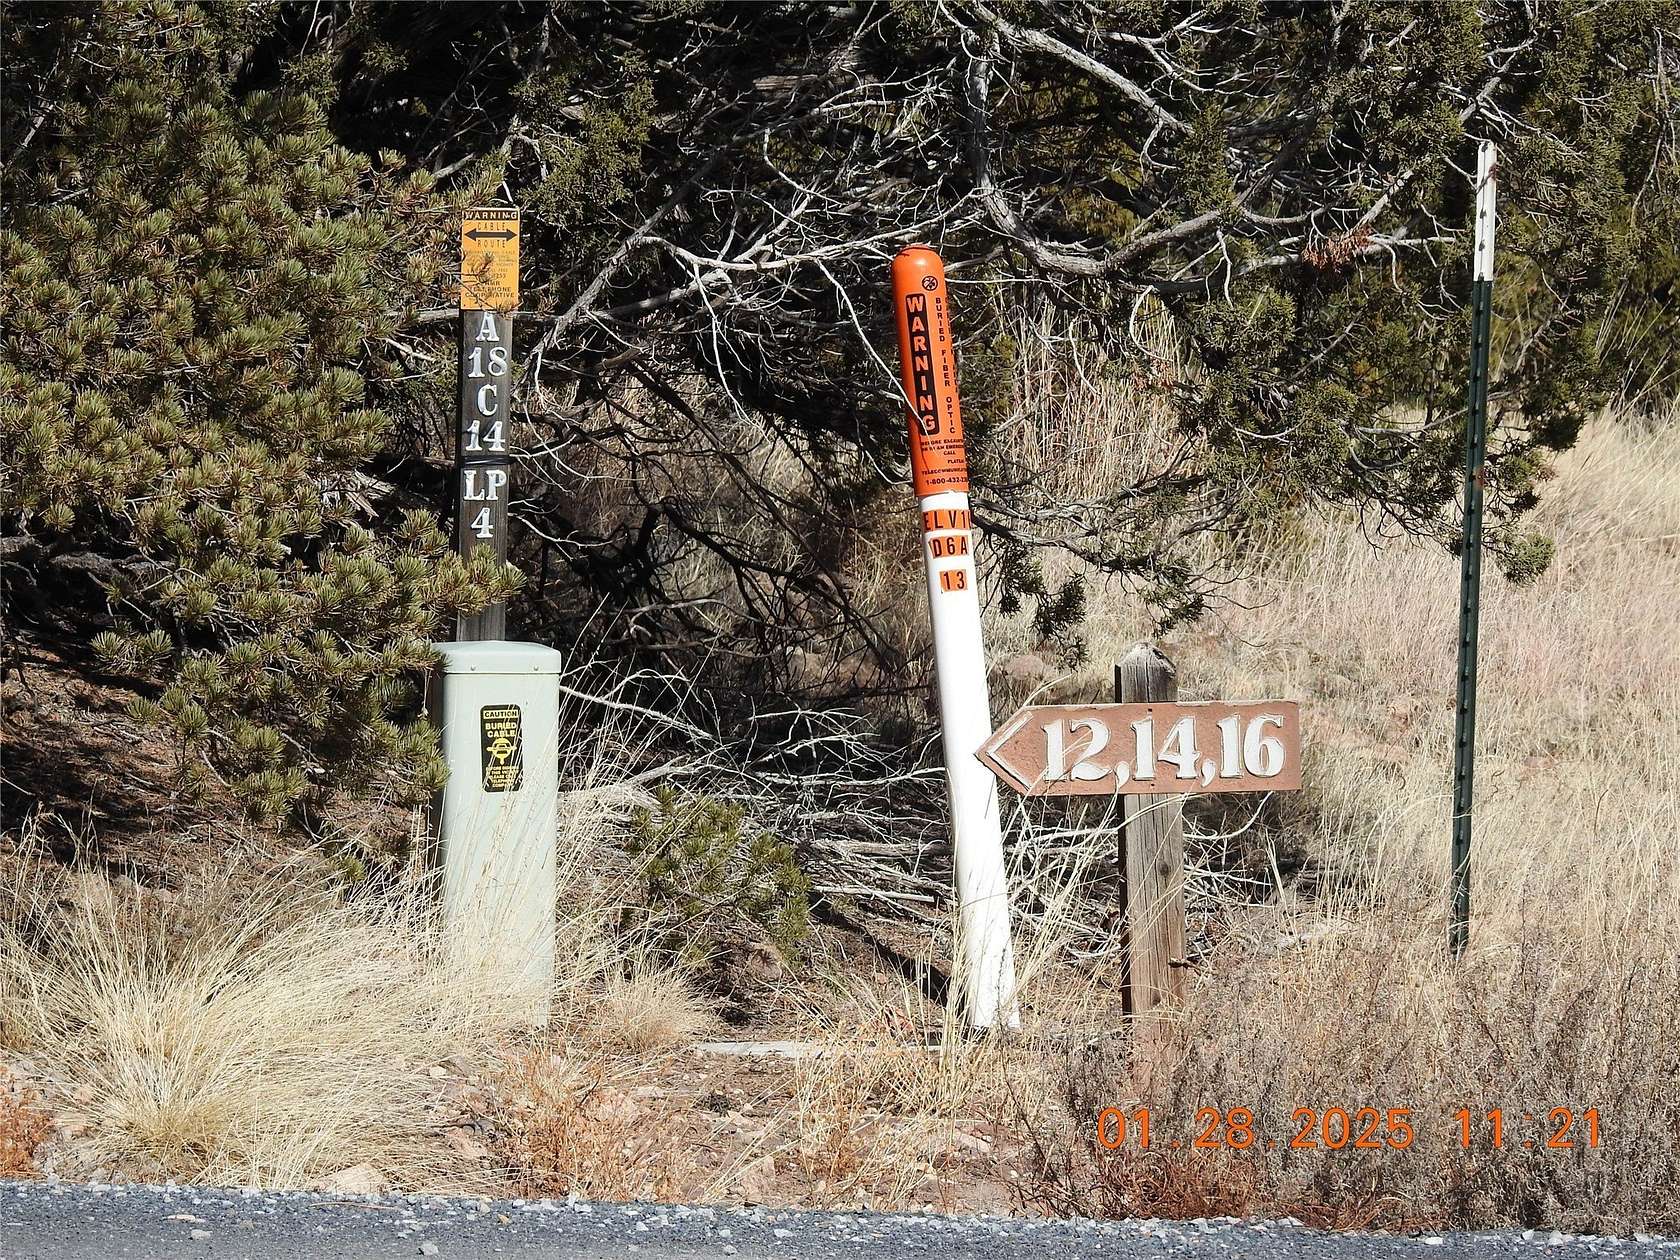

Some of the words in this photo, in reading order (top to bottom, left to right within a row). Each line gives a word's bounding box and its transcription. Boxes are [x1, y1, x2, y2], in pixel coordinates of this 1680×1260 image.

[464, 211, 517, 219] WARNING
[477, 222, 505, 230] CABLE
[477, 240, 505, 248] ROUTE
[475, 311, 500, 342] A
[467, 346, 508, 378] 18
[906, 295, 936, 431] WARNING
[935, 297, 945, 342] BURIED
[941, 349, 951, 387] FIBER
[946, 396, 956, 434] OPTIC
[477, 383, 498, 416] C
[465, 420, 506, 451] 14
[463, 469, 507, 501] LP
[470, 507, 494, 538] 4
[932, 536, 968, 557] D6A
[943, 570, 965, 590] 13
[485, 722, 517, 730] BURIED
[487, 730, 516, 738] CABLE
